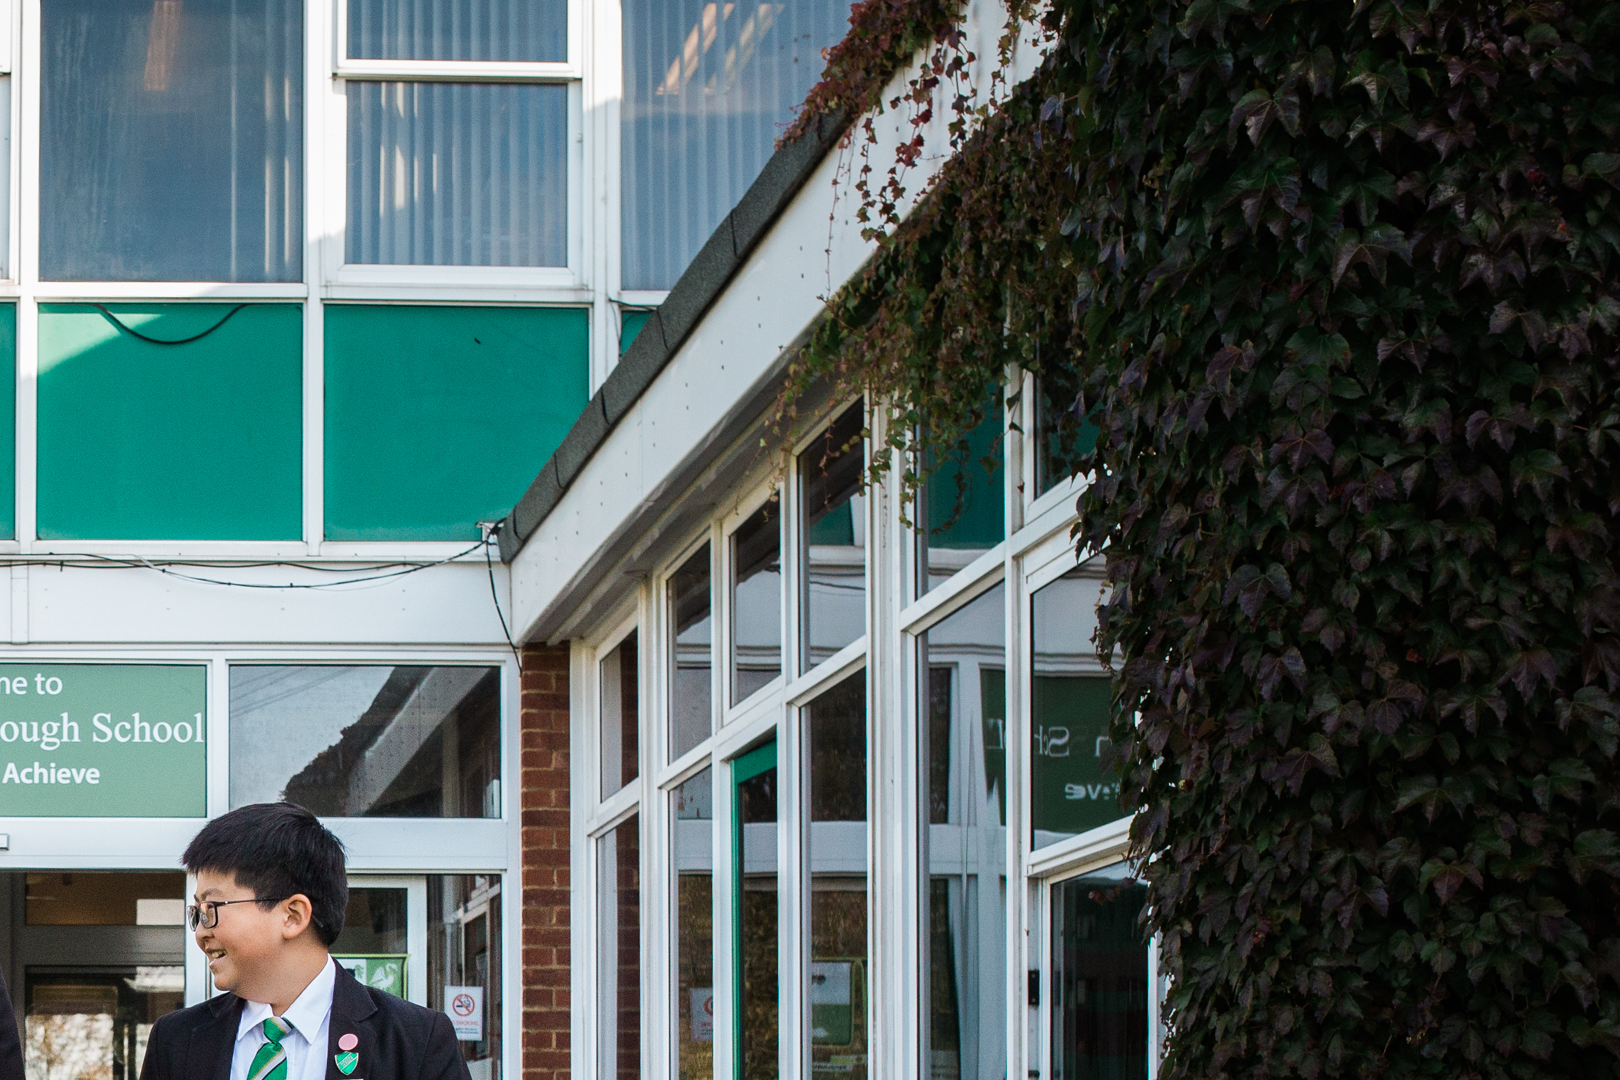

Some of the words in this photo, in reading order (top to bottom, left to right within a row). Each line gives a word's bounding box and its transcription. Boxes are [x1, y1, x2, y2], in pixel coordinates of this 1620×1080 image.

[35, 673, 63, 695] to
[92, 711, 205, 744] School
[2, 761, 101, 785] Achieve
